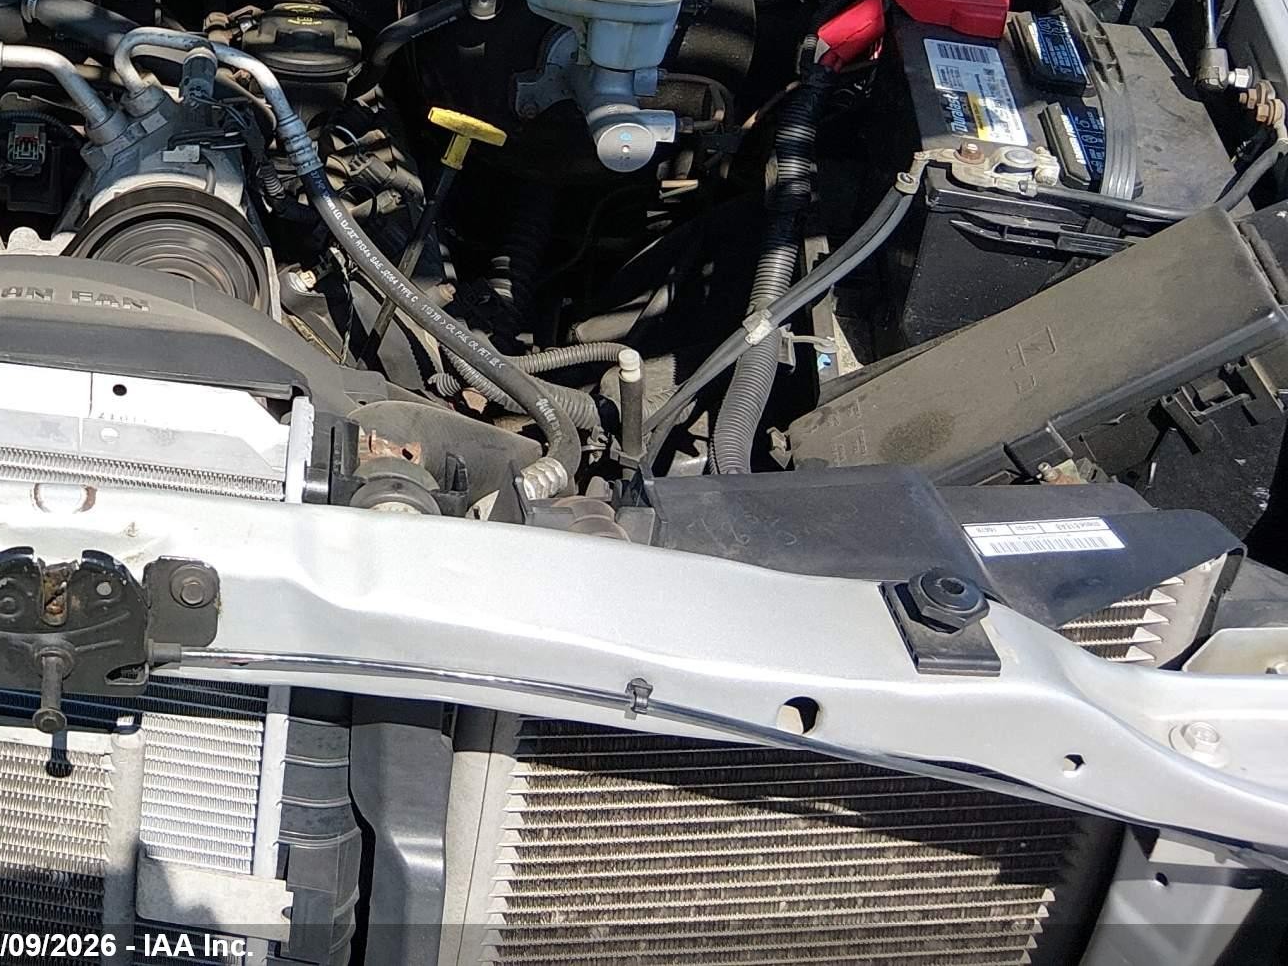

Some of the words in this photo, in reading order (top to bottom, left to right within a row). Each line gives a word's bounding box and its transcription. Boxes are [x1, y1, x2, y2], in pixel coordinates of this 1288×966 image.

[942, 90, 969, 134] Duralast
[71, 289, 152, 312] FAN
[369, 256, 382, 270] SAE
[397, 283, 414, 299] TYPE
[411, 295, 418, 303] C
